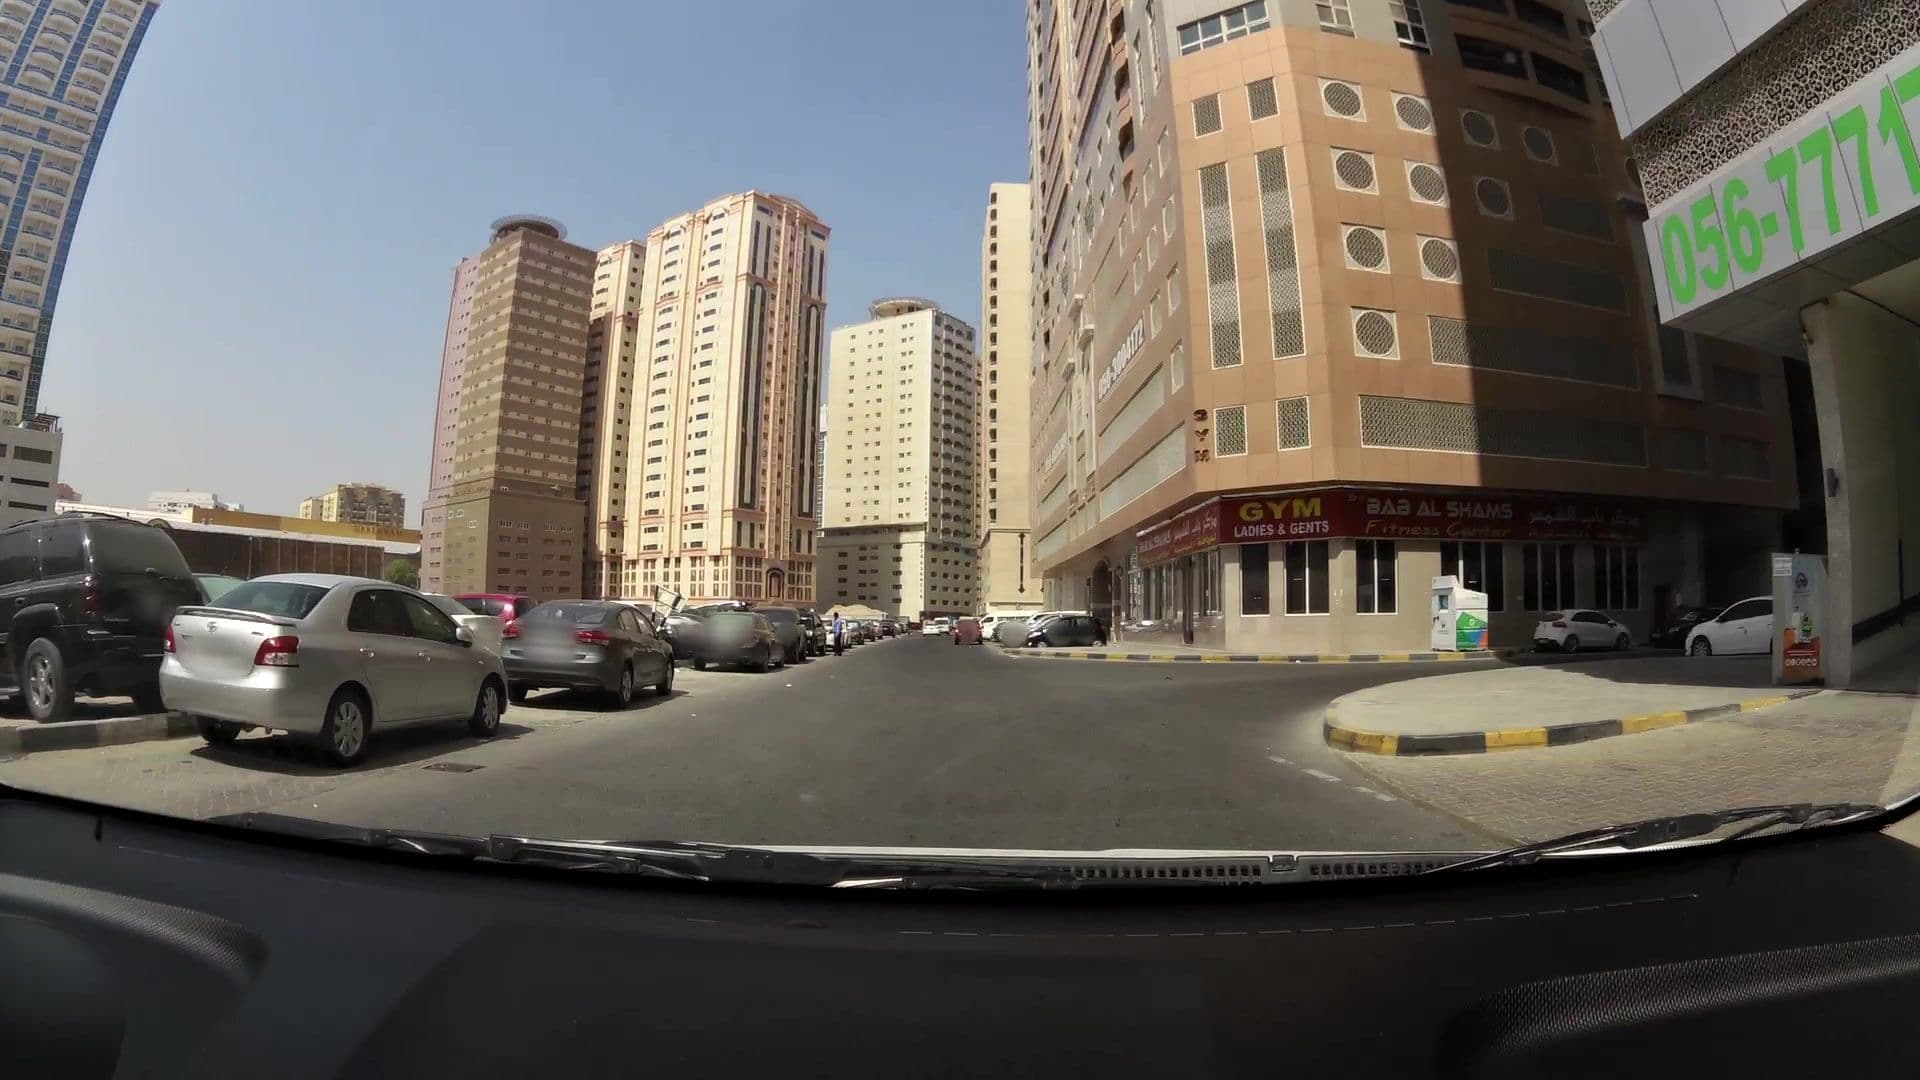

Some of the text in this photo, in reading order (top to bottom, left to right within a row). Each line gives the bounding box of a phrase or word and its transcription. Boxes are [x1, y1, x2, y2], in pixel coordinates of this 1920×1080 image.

[1239, 497, 1321, 521] GYM
[1366, 497, 1411, 516] BAB
[1416, 498, 1442, 516] AL
[1446, 500, 1513, 519] SHAMS
[1234, 520, 1329, 537] LADIES & GENTS
[1366, 519, 1440, 536] Fitness
